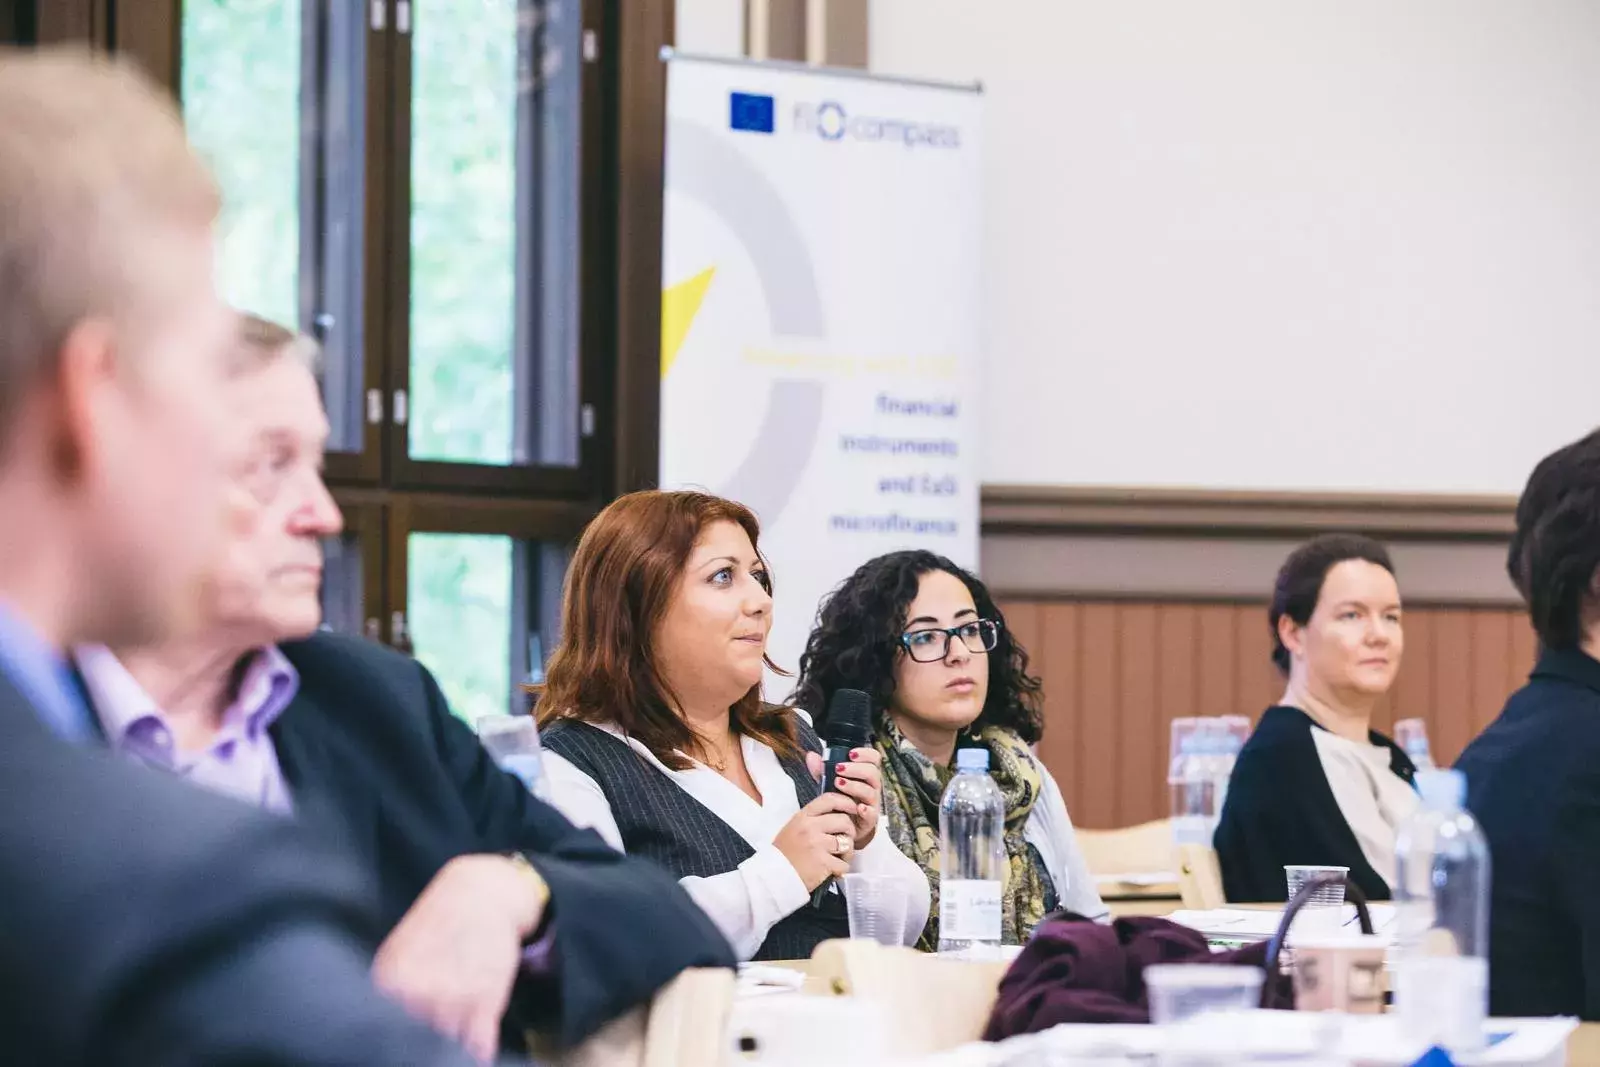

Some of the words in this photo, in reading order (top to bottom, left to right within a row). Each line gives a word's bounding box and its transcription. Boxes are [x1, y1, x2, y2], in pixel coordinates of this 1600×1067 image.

[876, 394, 957, 418] financial
[878, 477, 915, 496] and
[829, 511, 957, 536] microfinance
